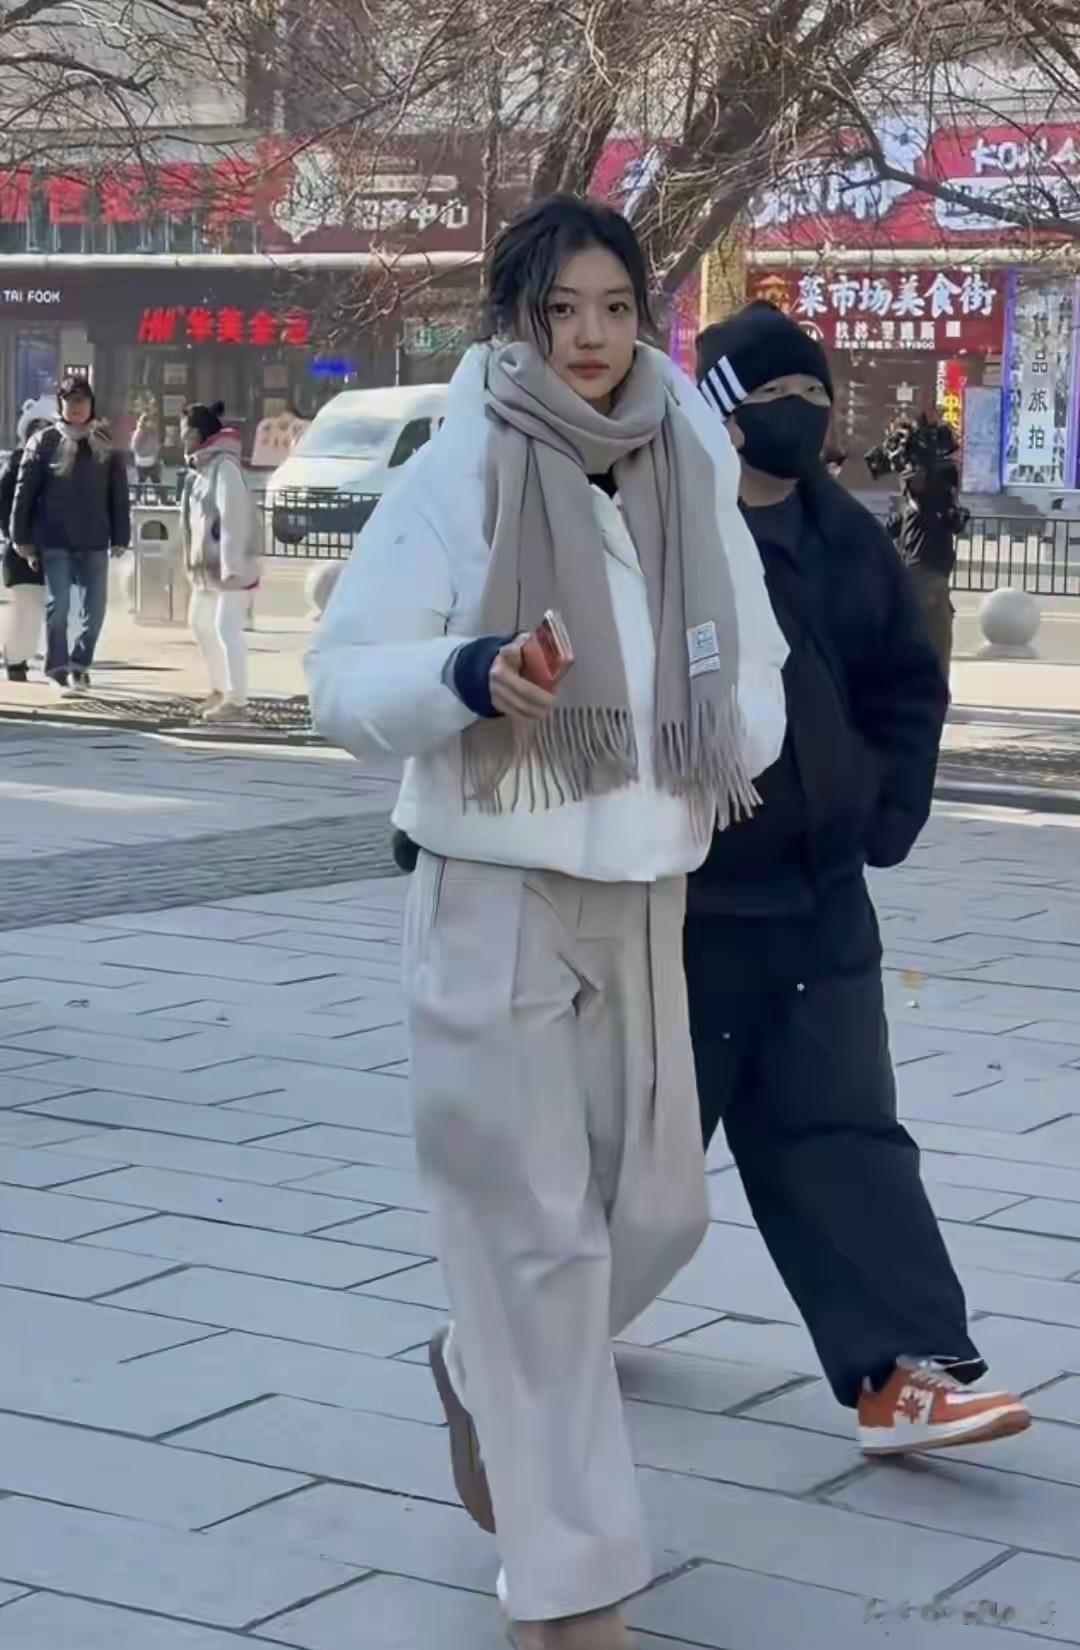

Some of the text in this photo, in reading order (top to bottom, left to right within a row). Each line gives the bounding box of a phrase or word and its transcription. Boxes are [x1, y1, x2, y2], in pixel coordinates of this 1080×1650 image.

[3, 290, 60, 303] TAI FOOK
[796, 272, 997, 319] 菜市场美食街
